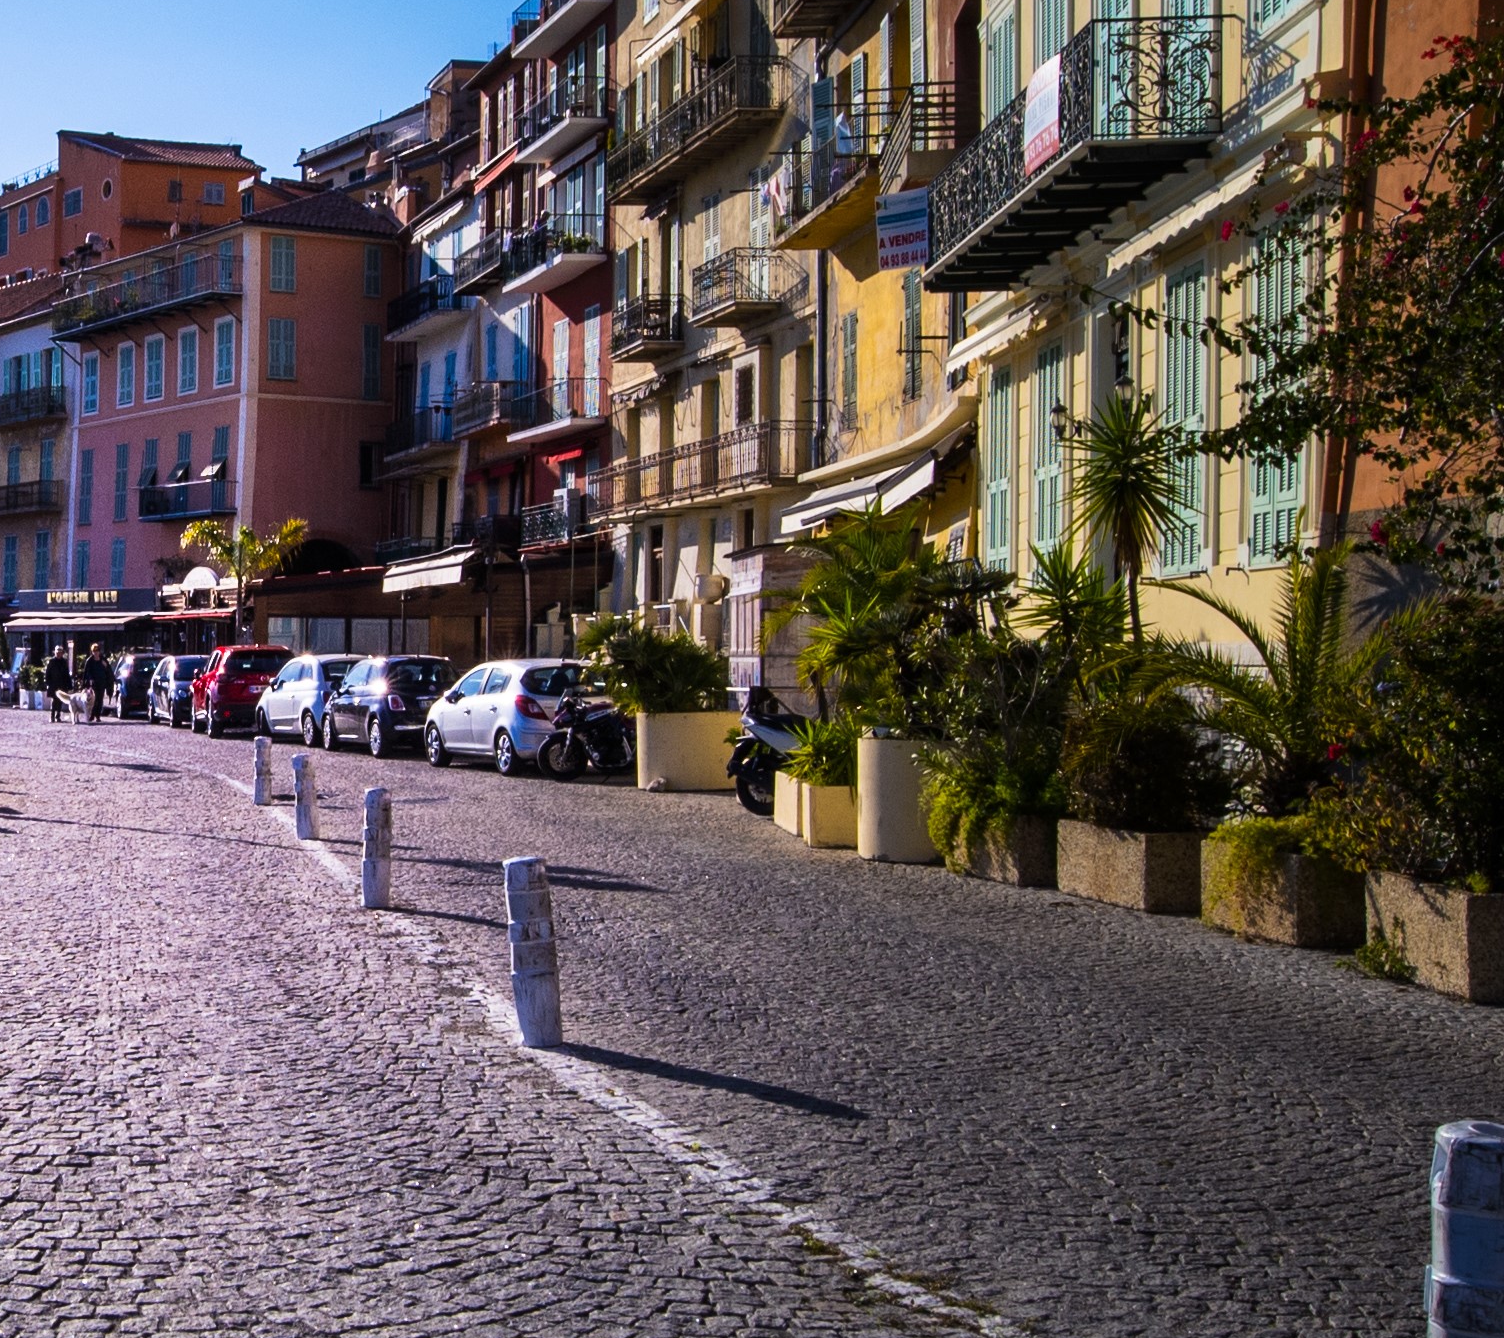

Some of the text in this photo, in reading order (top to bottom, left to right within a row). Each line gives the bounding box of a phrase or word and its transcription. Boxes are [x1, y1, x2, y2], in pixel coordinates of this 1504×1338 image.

[879, 230, 927, 249] A VENDRE
[880, 255, 890, 268] 04
[93, 590, 118, 603] BLEU
